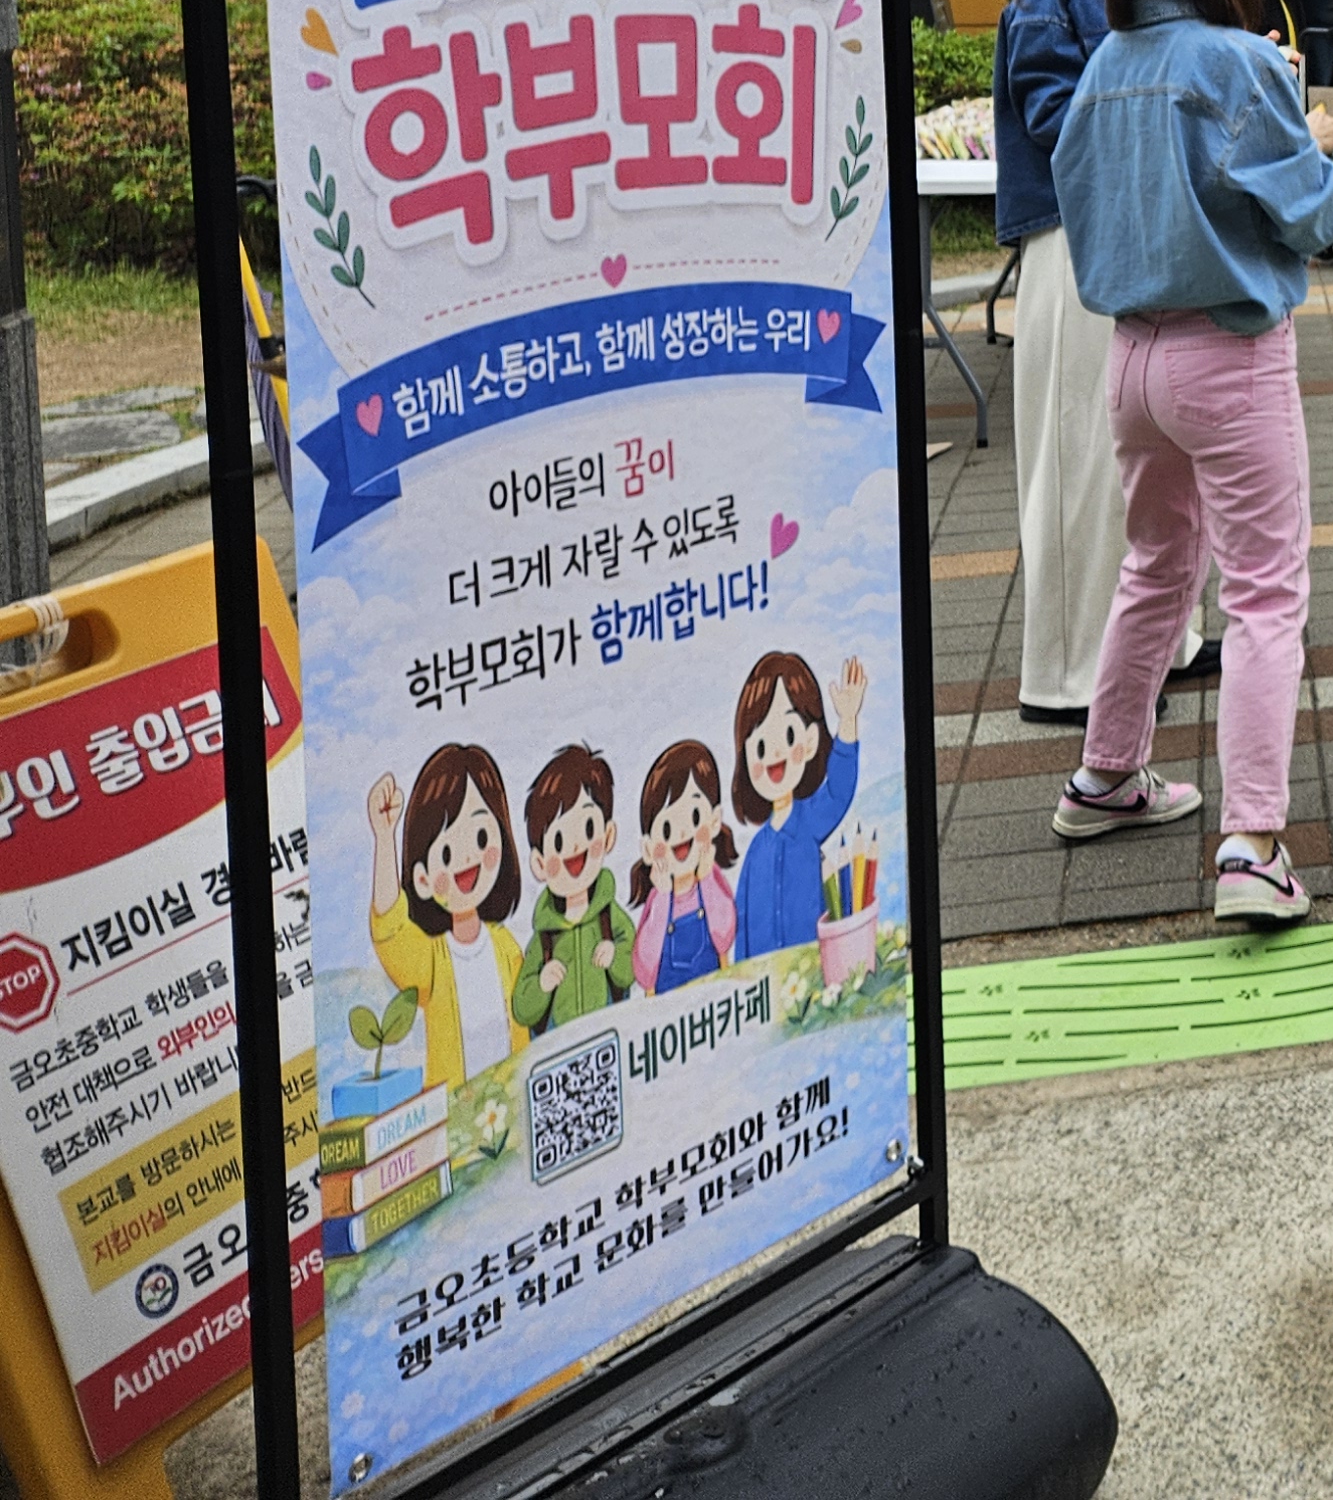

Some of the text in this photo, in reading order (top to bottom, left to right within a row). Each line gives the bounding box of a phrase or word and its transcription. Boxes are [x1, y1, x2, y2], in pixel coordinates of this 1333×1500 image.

[351, 3, 817, 245] 학부모회
[393, 306, 812, 438] 함께 소통하고, 함께 성장하는 우리
[488, 438, 676, 519] 아이들의 꿈이
[448, 494, 739, 609] 더 크게 자랄 수 있도록
[406, 560, 770, 712] 학부모회가 함께합니다!
[60, 881, 197, 972] 지킴이실
[0, 964, 41, 1000] TOP
[9, 1005, 143, 1094] 금오초중학교
[144, 959, 230, 1016] 학생들을
[628, 976, 773, 1083] 네이버카페
[25, 1088, 73, 1134] 안전
[73, 1045, 158, 1106] 대책으로
[157, 1000, 238, 1062] 외부인의
[40, 1082, 173, 1178] 협조해주시기
[76, 1173, 137, 1228] 본교를
[140, 1118, 238, 1188] 방문하시는
[321, 1136, 361, 1167] DREAM
[379, 1150, 417, 1190] LOVE
[92, 1191, 186, 1266] 지킴이실의
[186, 1157, 242, 1209] 안내에
[370, 1177, 439, 1235] TOGETHER
[393, 1075, 832, 1336] 금오초등학교 학부모회와 함께
[394, 1105, 851, 1382] 행복한 학교 문화를 만들어가요!
